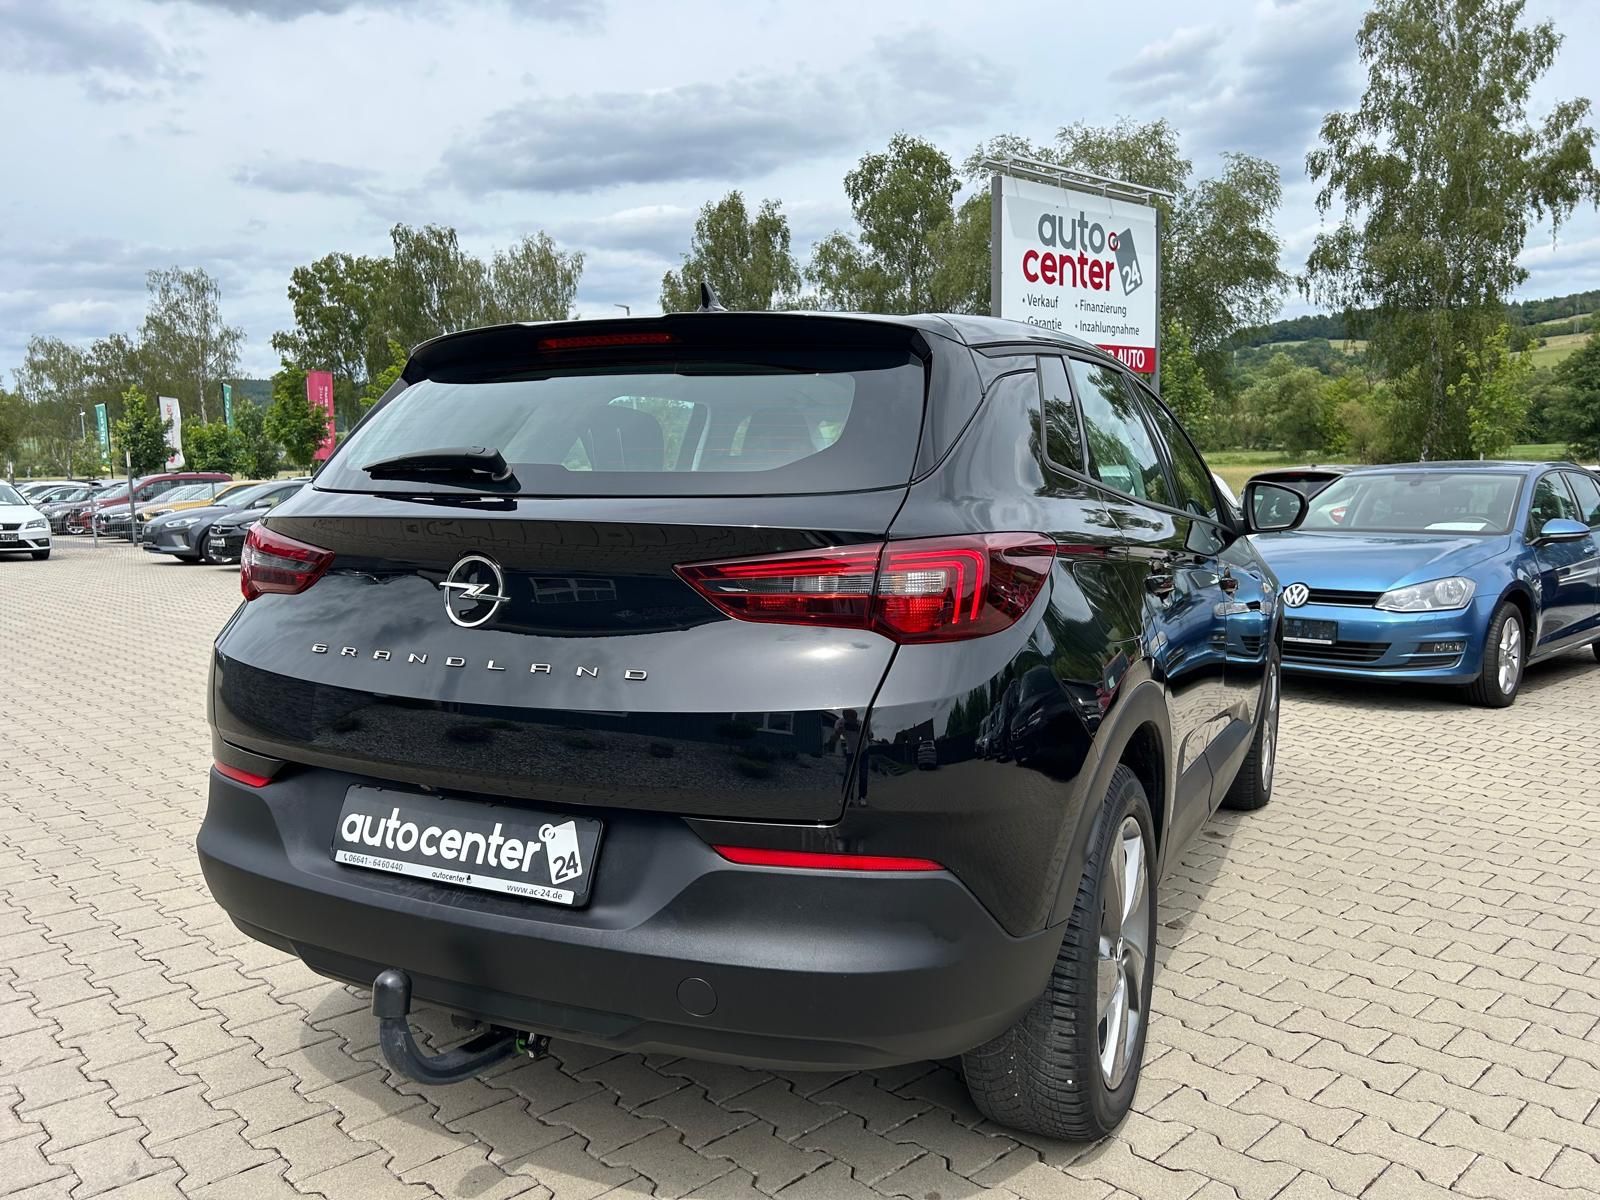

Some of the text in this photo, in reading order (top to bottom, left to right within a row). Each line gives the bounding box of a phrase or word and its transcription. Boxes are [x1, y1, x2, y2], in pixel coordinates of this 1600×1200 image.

[1038, 211, 1106, 254] auto
[1022, 249, 1115, 291] center
[1121, 259, 1141, 293] 24
[1027, 293, 1059, 309] Verkauf
[1080, 299, 1127, 318] Finanzierung
[1080, 320, 1140, 337] Inzahlungnahme
[1117, 348, 1146, 369] AUTO
[311, 643, 648, 681] GRANDLAND
[341, 807, 541, 873] autocenter
[431, 870, 466, 883] autocenter
[552, 850, 579, 880] 24
[506, 884, 563, 900] www.ac-24.de
